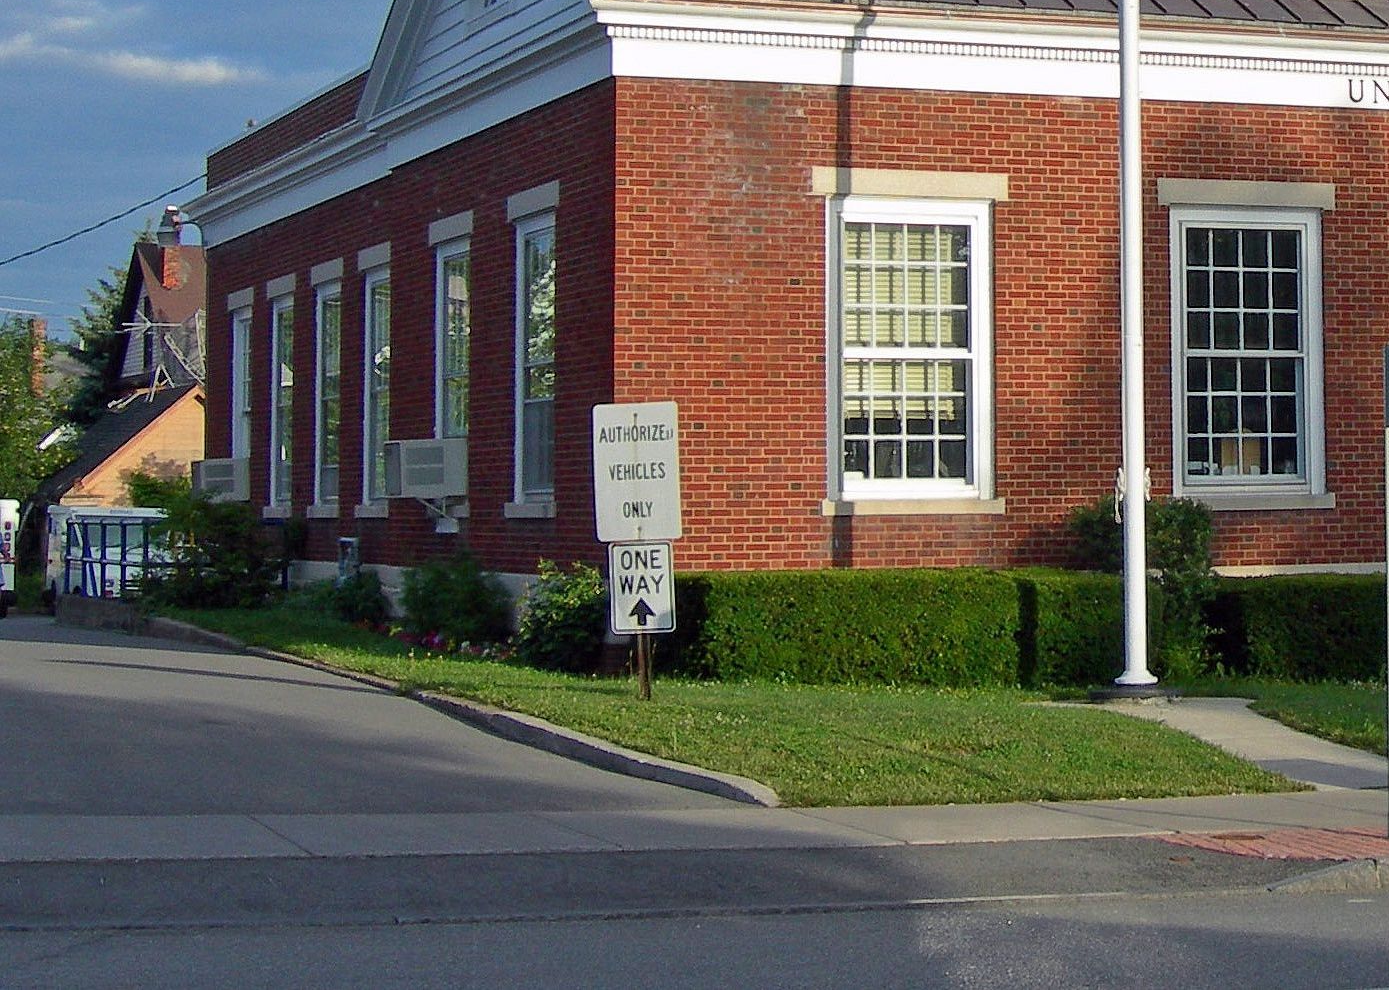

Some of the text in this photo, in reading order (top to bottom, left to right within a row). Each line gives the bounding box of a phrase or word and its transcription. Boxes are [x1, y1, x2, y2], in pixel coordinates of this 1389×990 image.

[599, 424, 674, 443] AUTHORIZED
[609, 462, 666, 481] VEHICLES
[623, 501, 653, 518] ONLY
[621, 549, 663, 570] ONE
[619, 574, 664, 595] WAY
